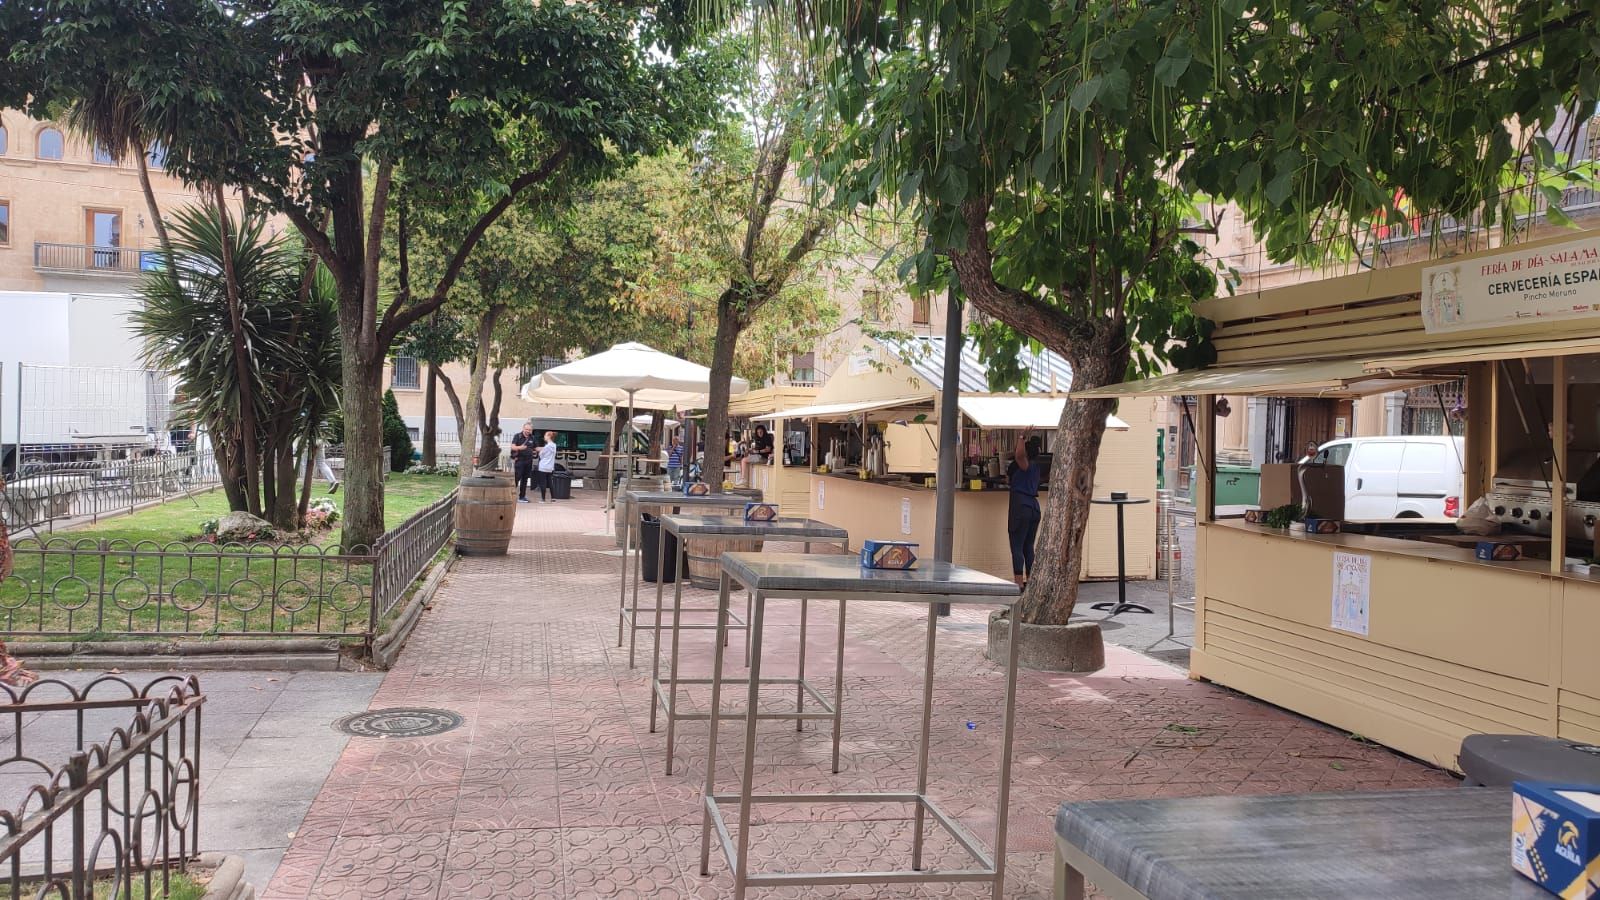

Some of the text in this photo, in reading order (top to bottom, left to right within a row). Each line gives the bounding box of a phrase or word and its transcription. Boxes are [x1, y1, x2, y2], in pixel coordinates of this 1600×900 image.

[1488, 268, 1600, 296] CERVECERÍA ESPA
[1524, 288, 1577, 301] Pincho Moruno
